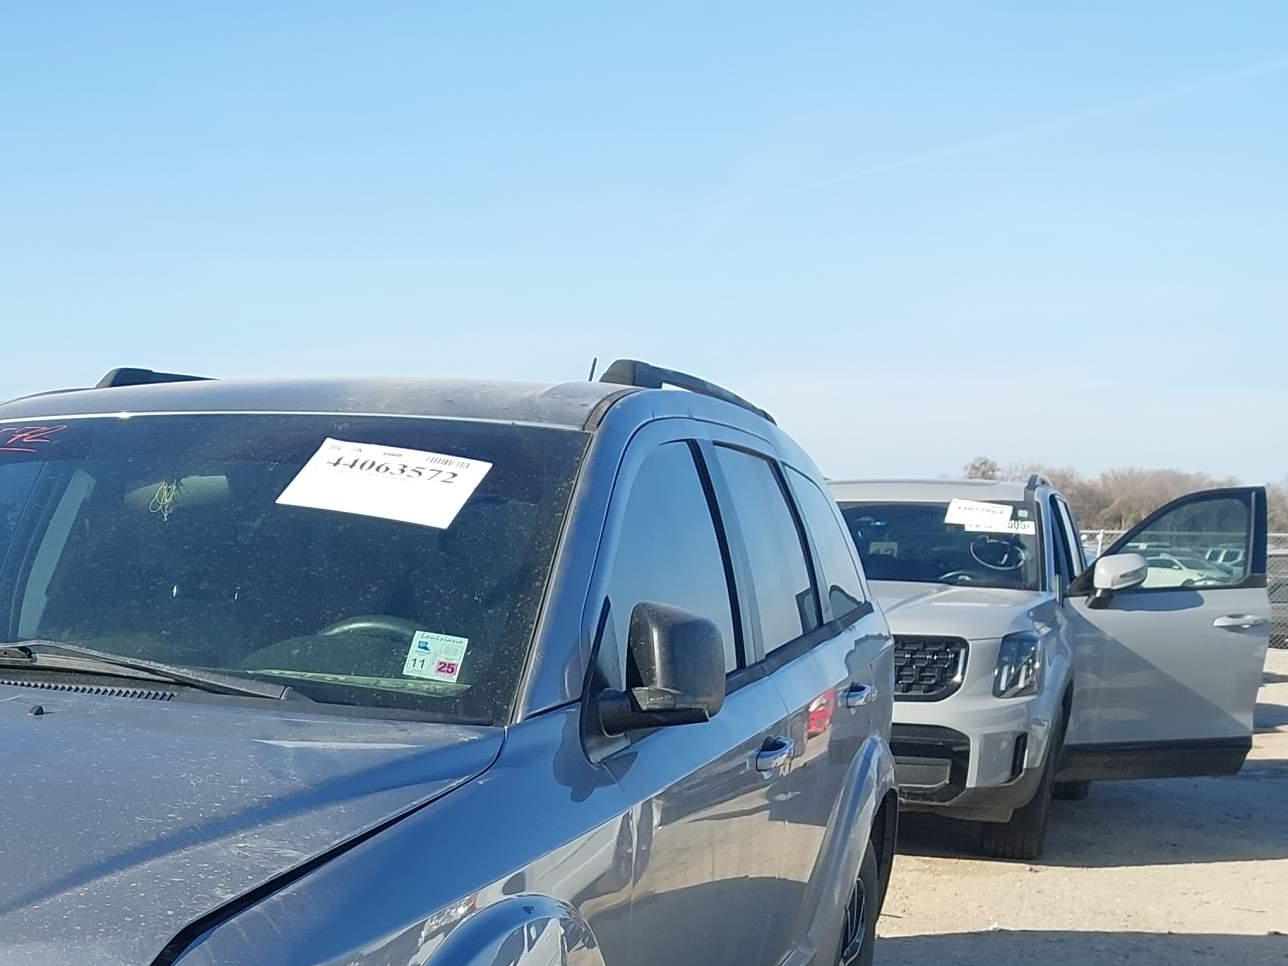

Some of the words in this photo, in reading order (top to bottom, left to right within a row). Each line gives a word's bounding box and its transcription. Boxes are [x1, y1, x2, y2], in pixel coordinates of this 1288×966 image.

[326, 456, 459, 485] 44063572
[411, 656, 425, 669] 11
[437, 661, 457, 674] 25
